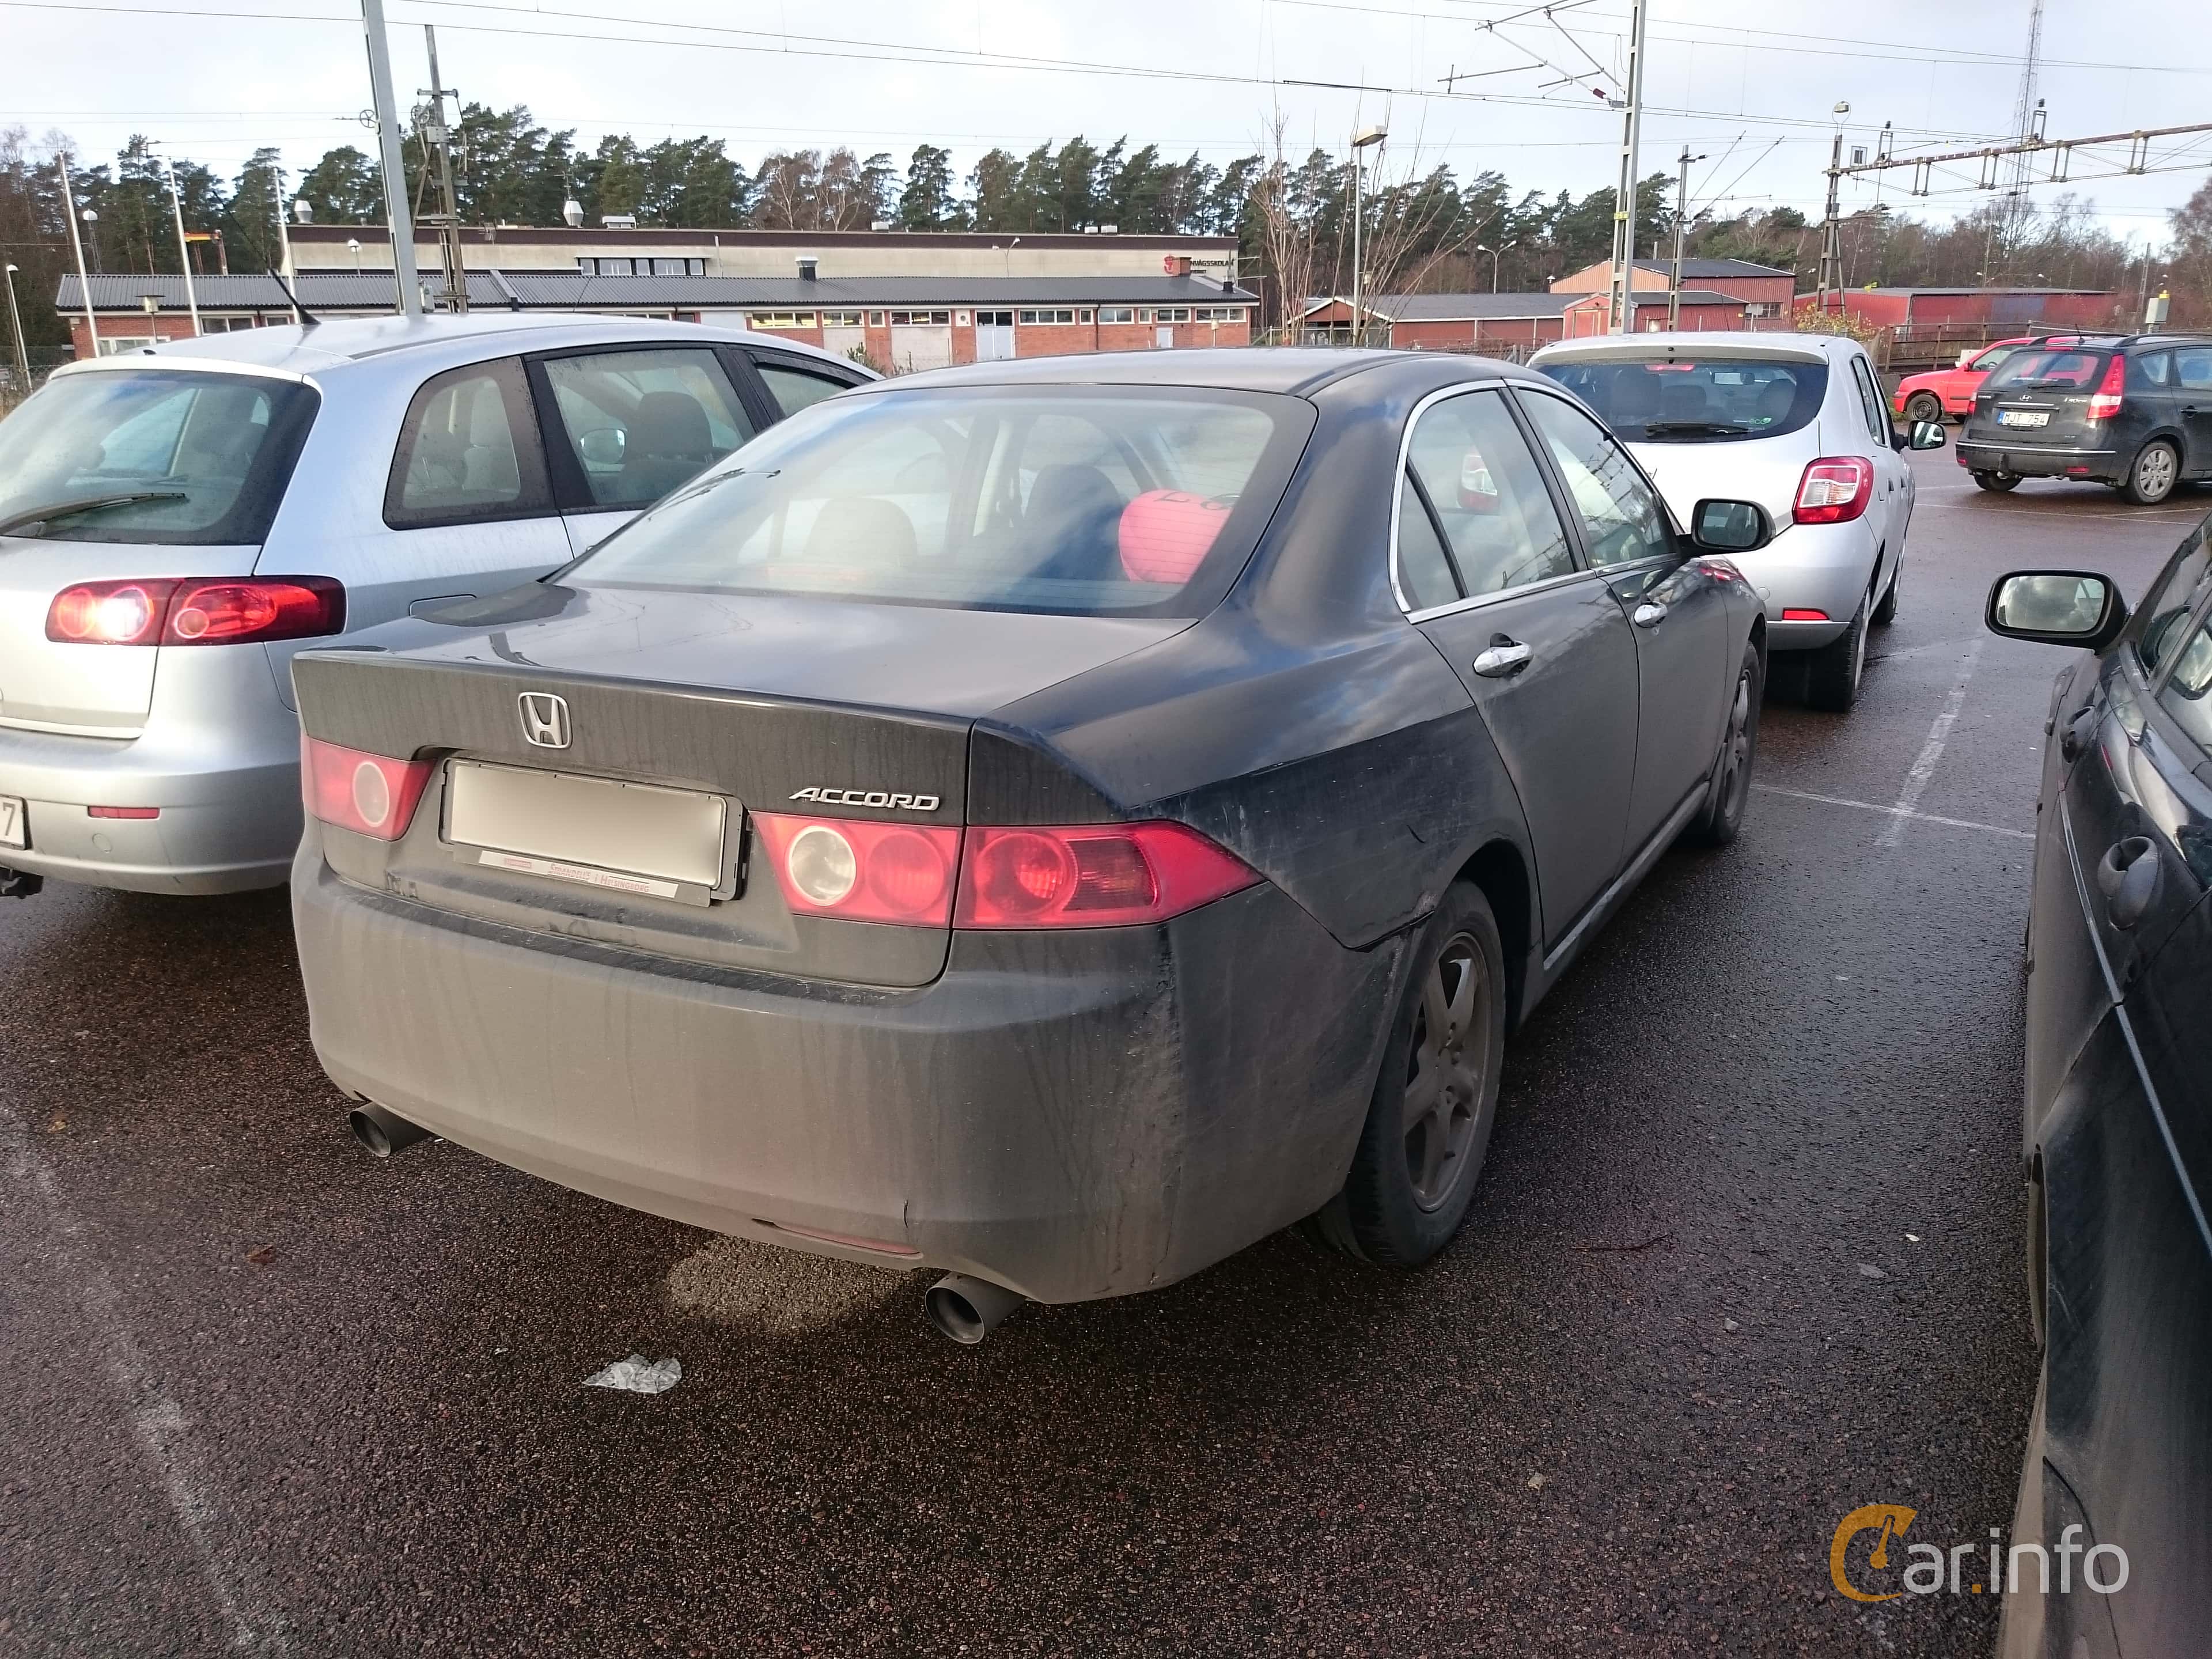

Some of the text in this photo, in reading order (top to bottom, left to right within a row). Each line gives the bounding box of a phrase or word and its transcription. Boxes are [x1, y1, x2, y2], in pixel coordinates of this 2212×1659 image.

[2005, 413, 2045, 424] MJT 754
[788, 787, 940, 811] ACCORD
